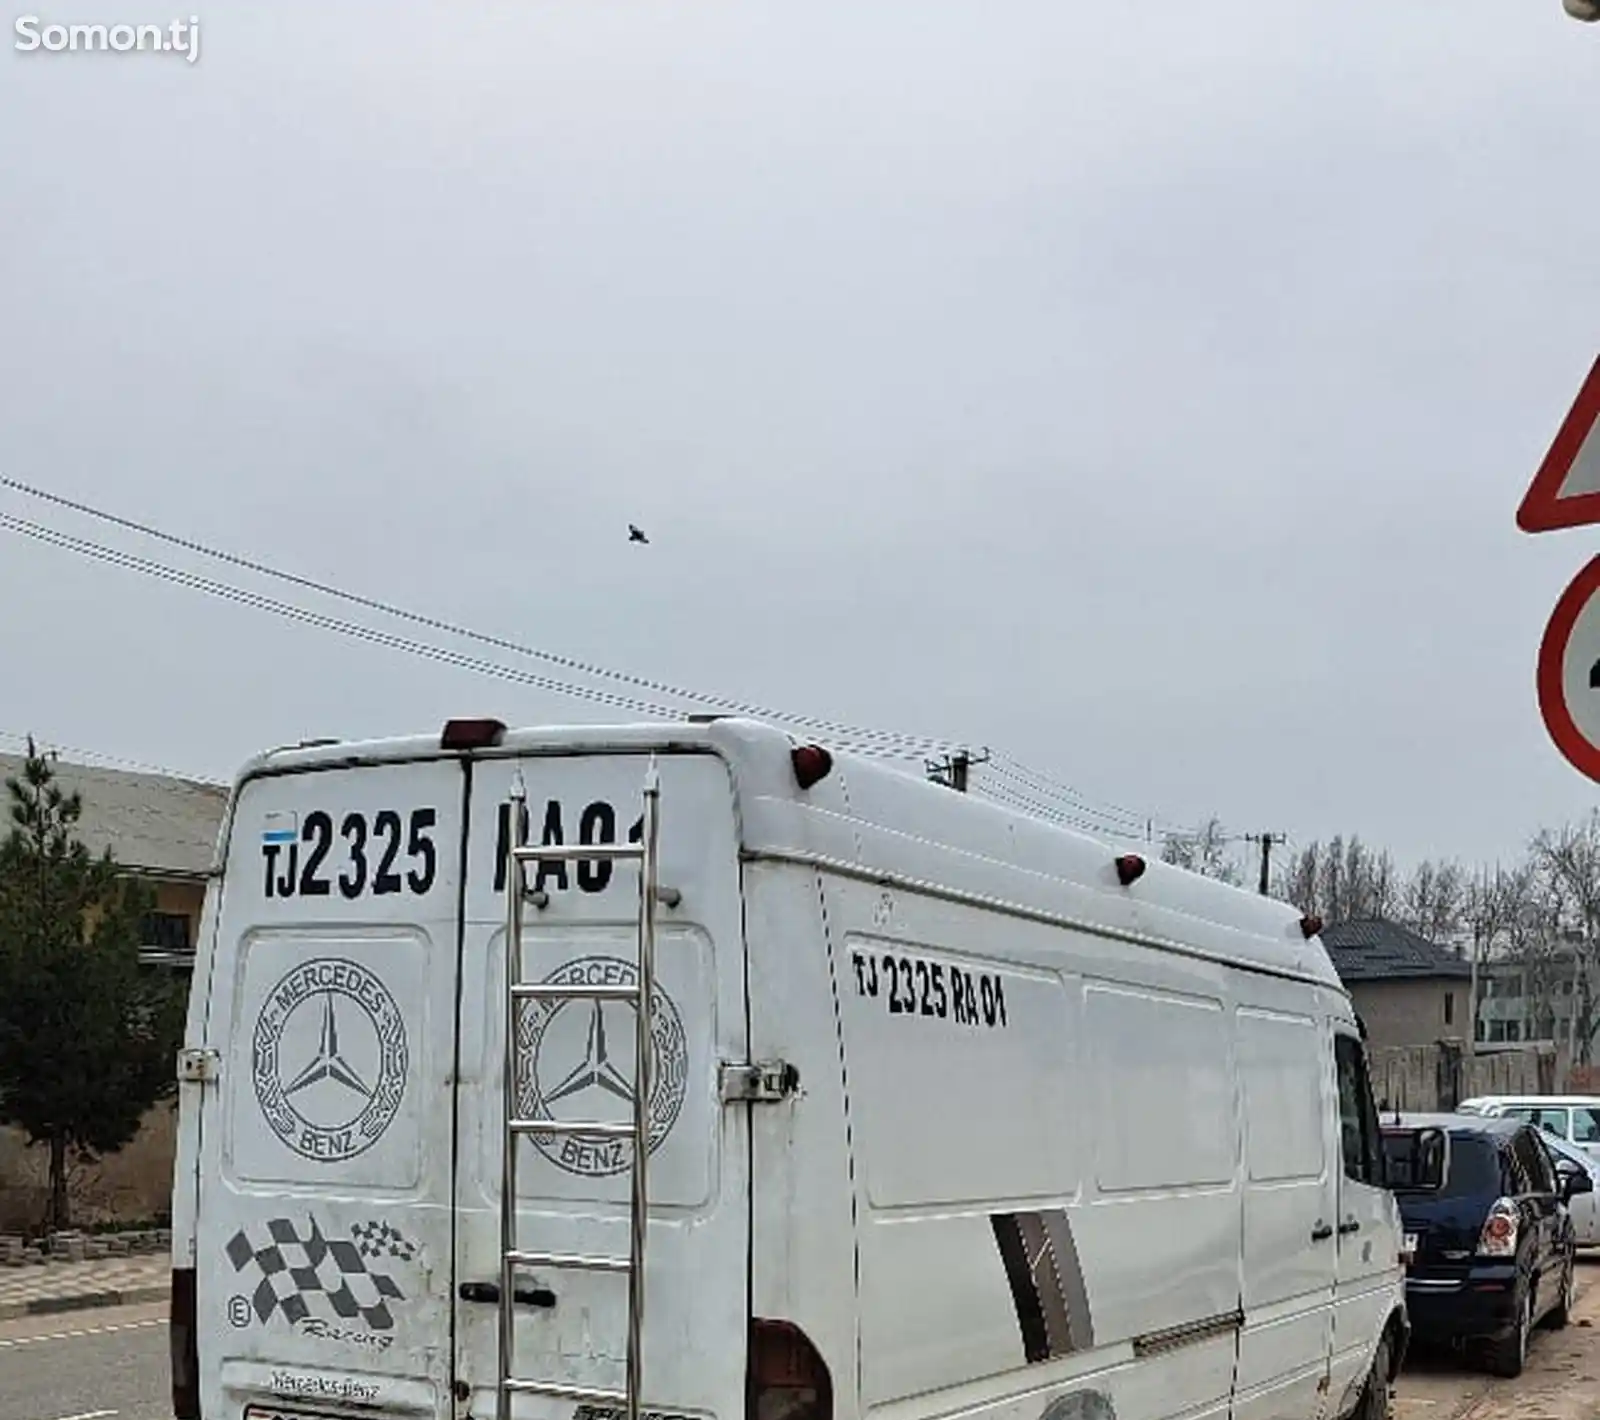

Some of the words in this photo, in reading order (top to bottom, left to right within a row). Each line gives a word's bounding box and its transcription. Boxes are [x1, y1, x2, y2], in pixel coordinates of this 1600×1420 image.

[275, 964, 386, 1014] MERCEDES
[852, 951, 878, 997] TJ
[882, 955, 947, 1018] 2325
[300, 1128, 357, 1155] BENZ
[559, 1138, 625, 1170] BENZ
